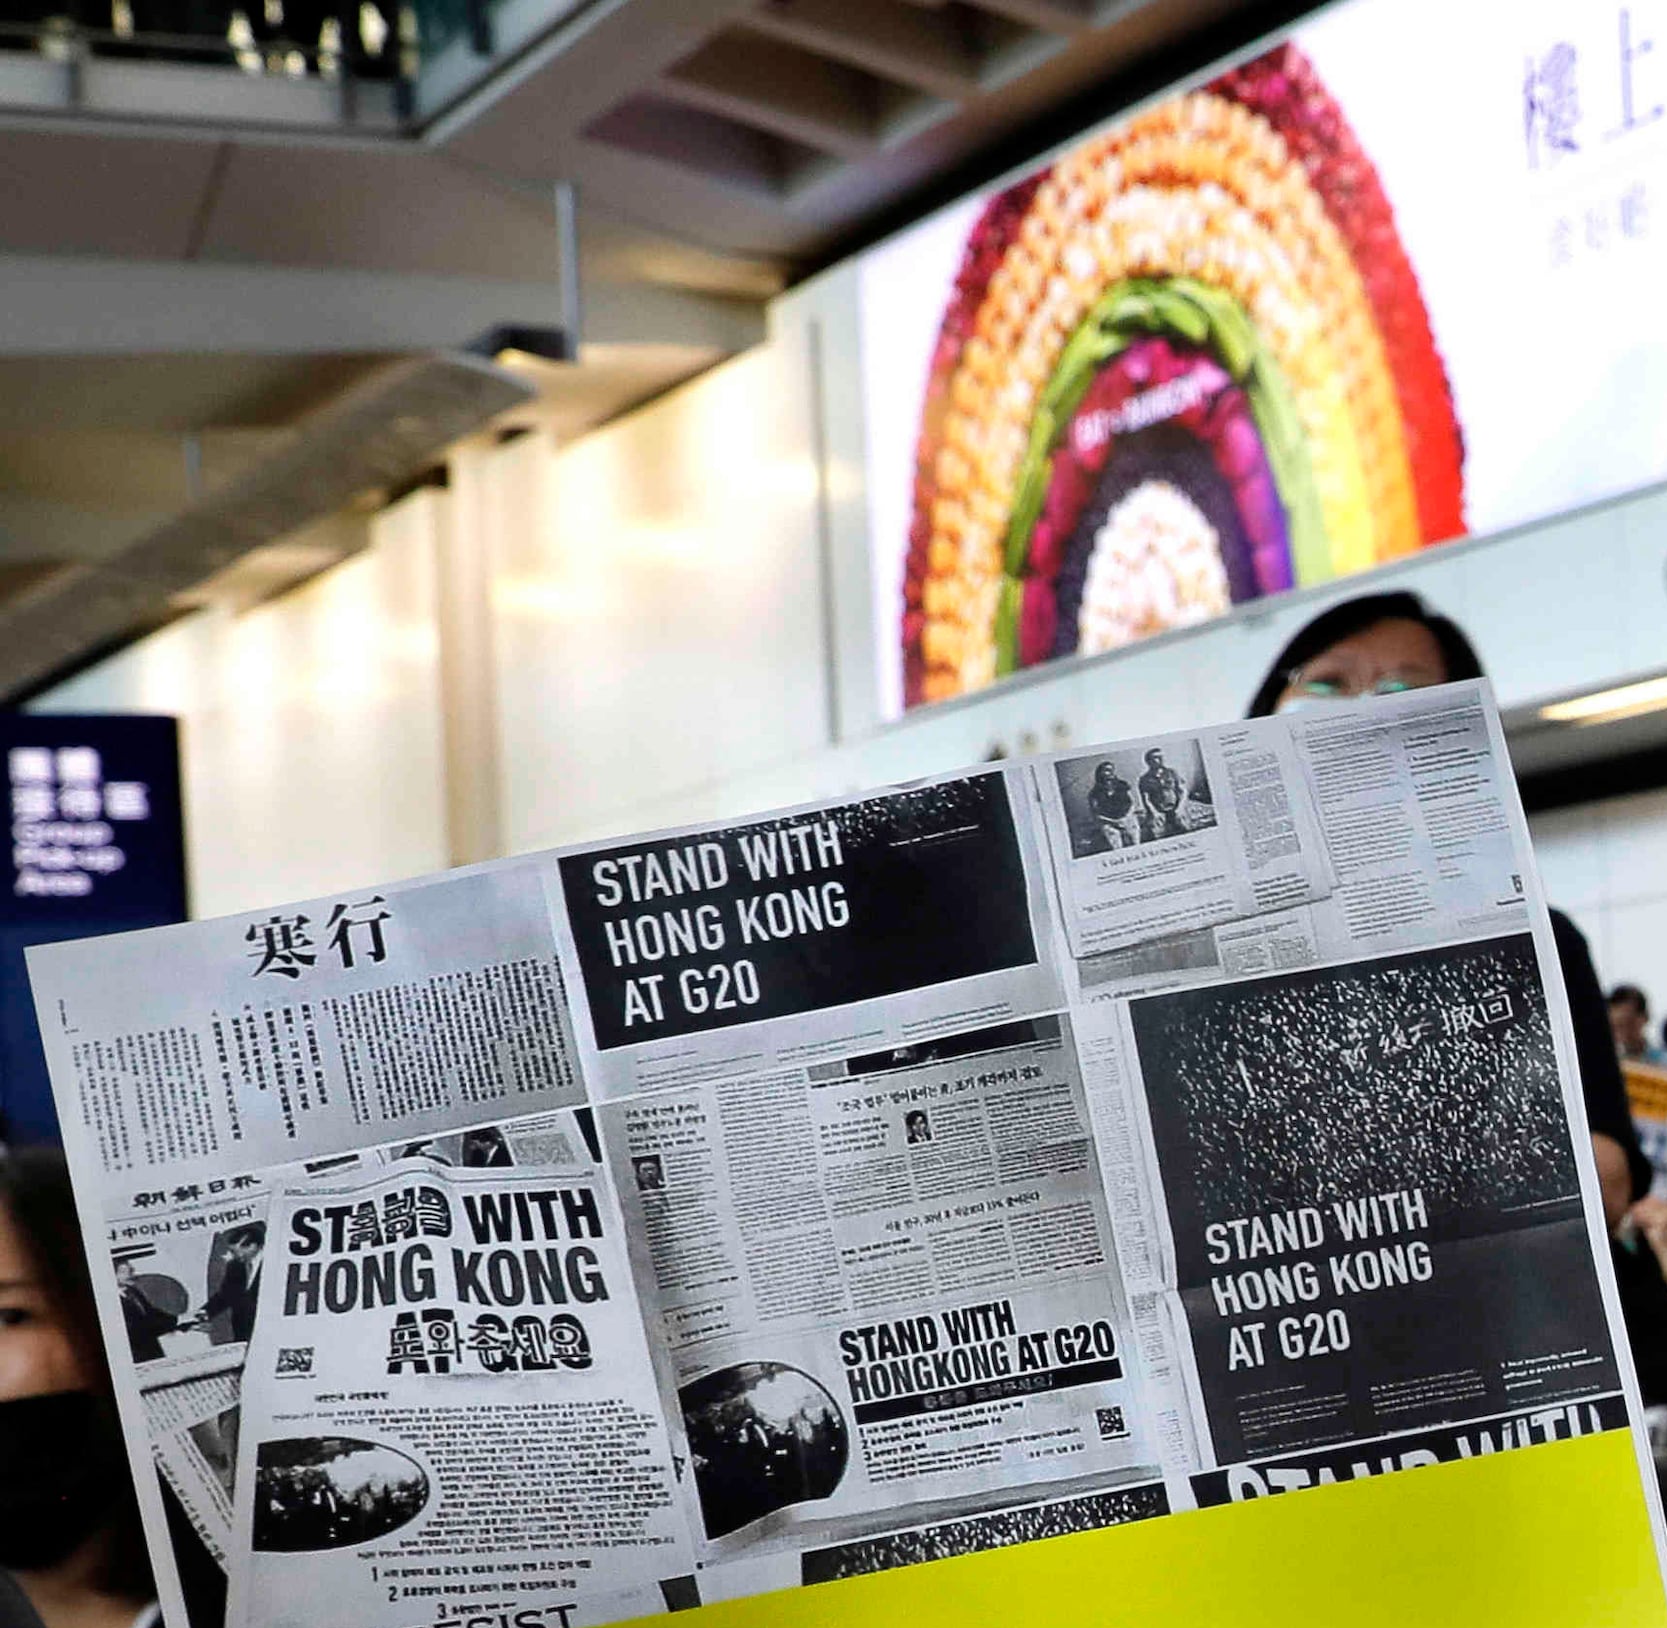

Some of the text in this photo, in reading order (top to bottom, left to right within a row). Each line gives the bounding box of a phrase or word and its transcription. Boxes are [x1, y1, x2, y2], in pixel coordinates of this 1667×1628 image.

[592, 820, 844, 907] STAND WITH
[245, 895, 392, 979] 寒行
[604, 881, 850, 967] HONG KONG
[624, 959, 761, 1026] AT G20
[289, 1186, 604, 1256] STAND WITH
[1205, 1188, 1430, 1265] STAND WITH
[284, 1243, 609, 1316] HONG KONG
[1211, 1241, 1434, 1317] HONG KONG
[839, 1299, 1016, 1366] STAND WITH
[846, 1320, 1116, 1403] HONGKONG AT G20
[1228, 1309, 1352, 1371] AT G20
